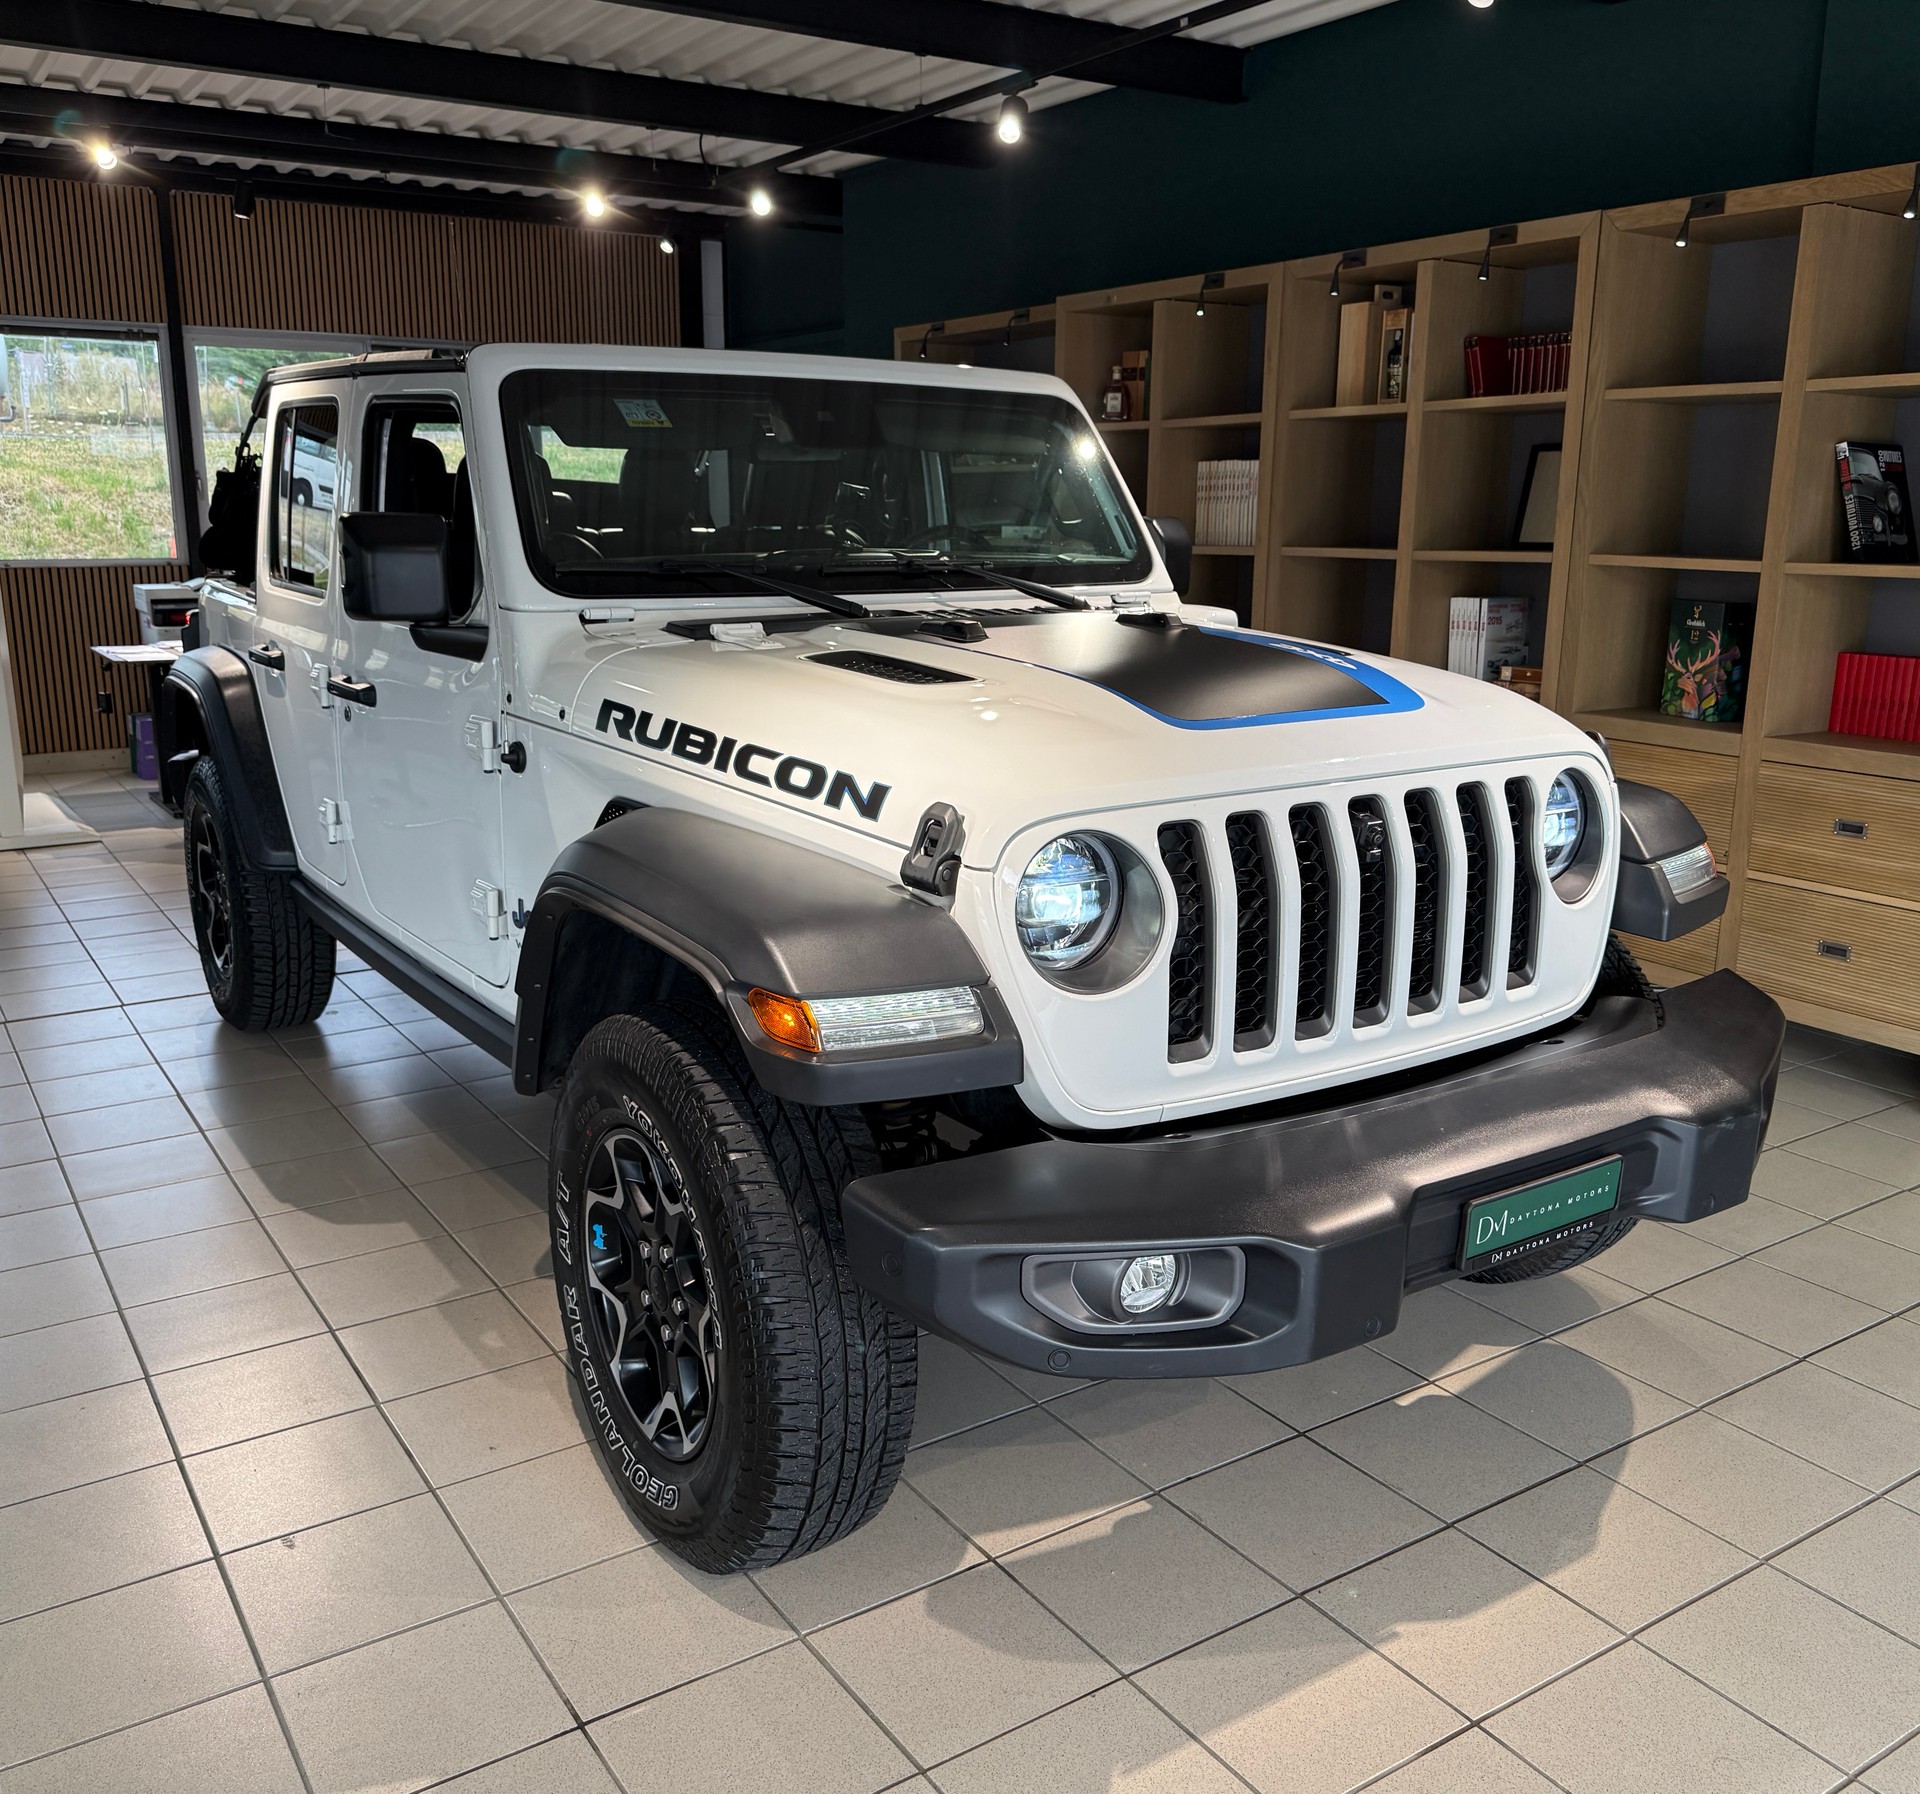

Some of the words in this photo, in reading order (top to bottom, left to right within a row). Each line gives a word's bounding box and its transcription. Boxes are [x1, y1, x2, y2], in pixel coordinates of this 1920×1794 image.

[1845, 494, 1858, 531] VOITURES
[1850, 531, 1861, 550] 1200
[1488, 616, 1502, 625] 2015
[595, 697, 893, 823] RUBICON
[555, 1170, 572, 1265] A/T
[623, 1094, 723, 1350] YOKOHAMA
[1509, 1202, 1560, 1225] DAYTONA
[1567, 1185, 1610, 1205] MOTORS
[1505, 1237, 1550, 1257] DAYTONA
[1556, 1221, 1594, 1240] MOTORS
[563, 1284, 679, 1510] GEOLANDAR
